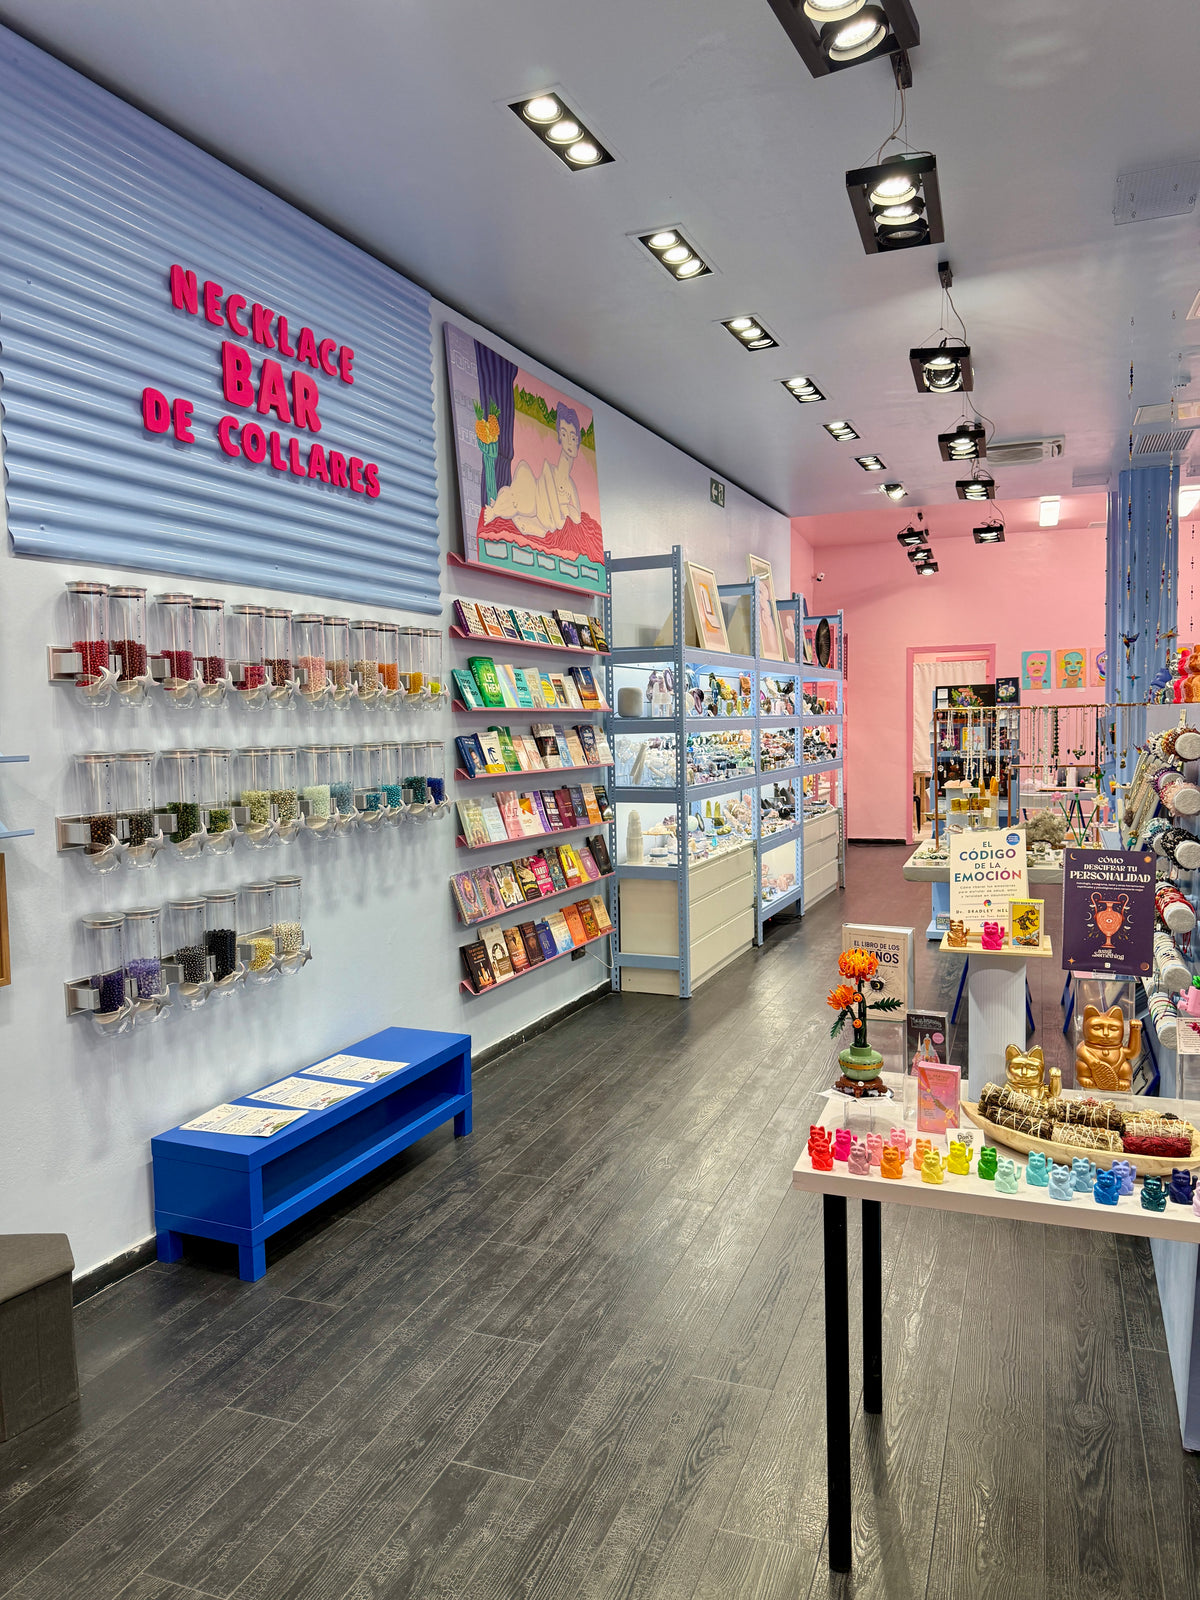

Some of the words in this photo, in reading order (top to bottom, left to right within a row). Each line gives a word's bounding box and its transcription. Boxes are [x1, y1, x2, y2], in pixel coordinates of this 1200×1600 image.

[169, 264, 355, 385] NECKLACE
[221, 341, 321, 432] BAR
[142, 387, 195, 444] DE
[218, 415, 380, 498] COLLARES
[483, 673, 495, 683] LET
[959, 847, 1016, 862] CÓDIGO
[1098, 855, 1124, 864] CÓMO
[954, 867, 1022, 883] EMOCIÓN
[1084, 864, 1125, 872] DESCIFRAR
[1070, 870, 1151, 883] PERSONALIDAD
[861, 941, 879, 949] LIBRO
